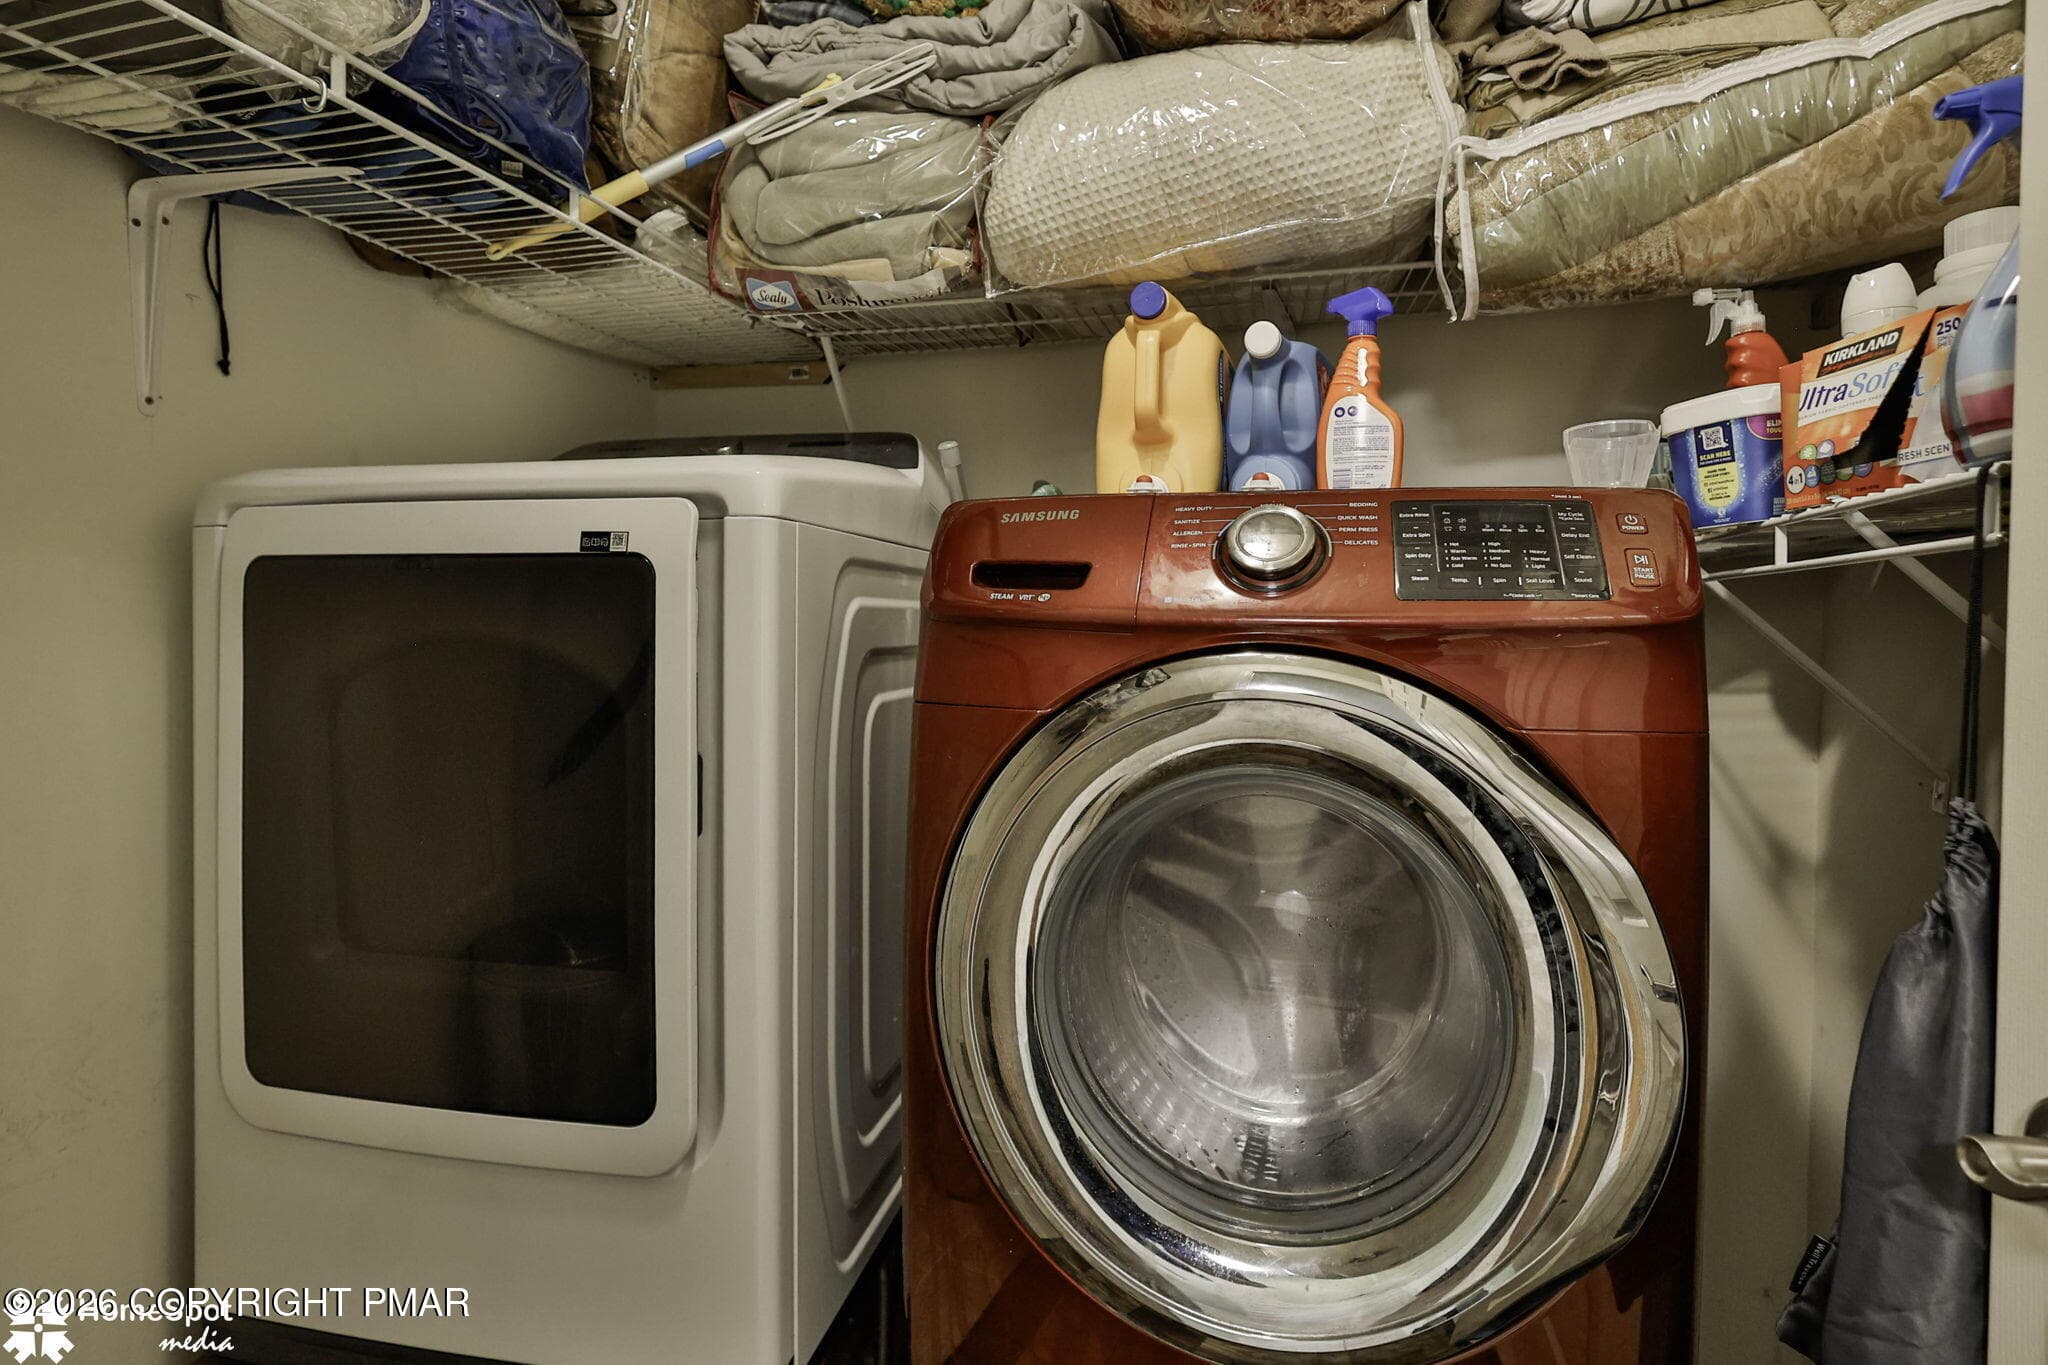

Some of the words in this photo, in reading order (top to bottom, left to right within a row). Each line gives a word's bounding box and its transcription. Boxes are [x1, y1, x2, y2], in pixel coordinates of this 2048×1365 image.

[757, 289, 788, 305] Sealy
[1936, 317, 1961, 336] 250
[1823, 331, 1899, 367] KIRKLAND
[1898, 449, 1922, 462] RESH
[1924, 443, 1950, 457] SCEN
[1001, 509, 1080, 523] SAMSUNG
